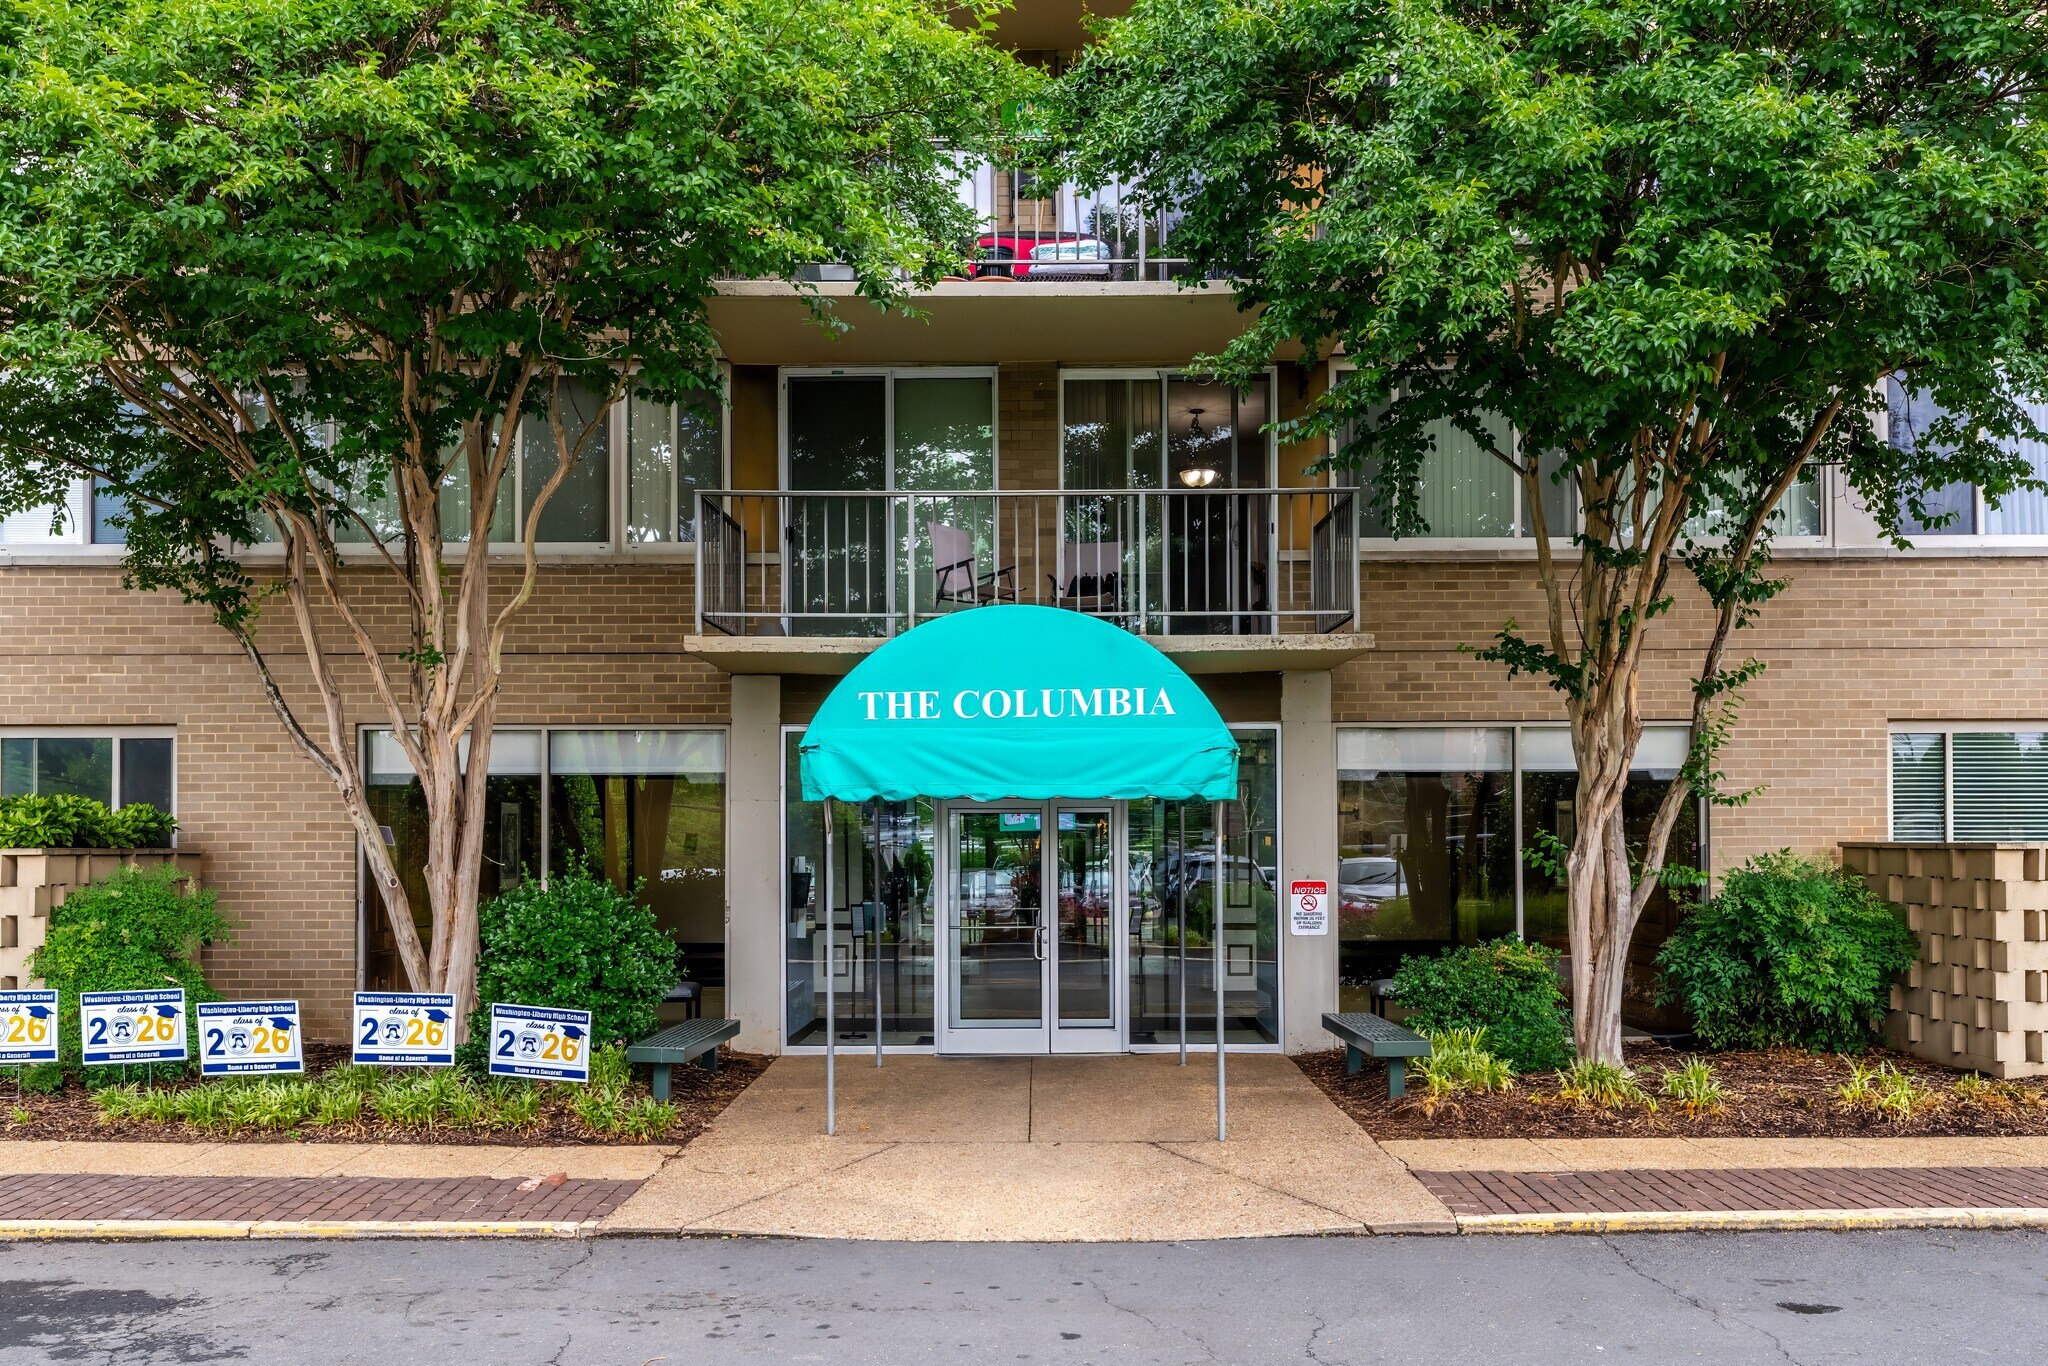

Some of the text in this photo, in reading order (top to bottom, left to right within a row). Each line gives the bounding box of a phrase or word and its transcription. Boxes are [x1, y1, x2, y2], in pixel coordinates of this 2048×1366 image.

[857, 686, 1177, 720] THE COLUMBIA
[84, 994, 143, 1003] Washington-Liberty
[358, 996, 415, 1004] Washington-Liberty
[12, 1005, 21, 1014] of
[139, 1005, 148, 1014] of
[389, 1007, 420, 1017] class of
[496, 1008, 552, 1019] Washington-Liberty
[567, 1014, 587, 1022] School
[255, 1017, 263, 1026] of
[526, 1021, 556, 1032] class of
